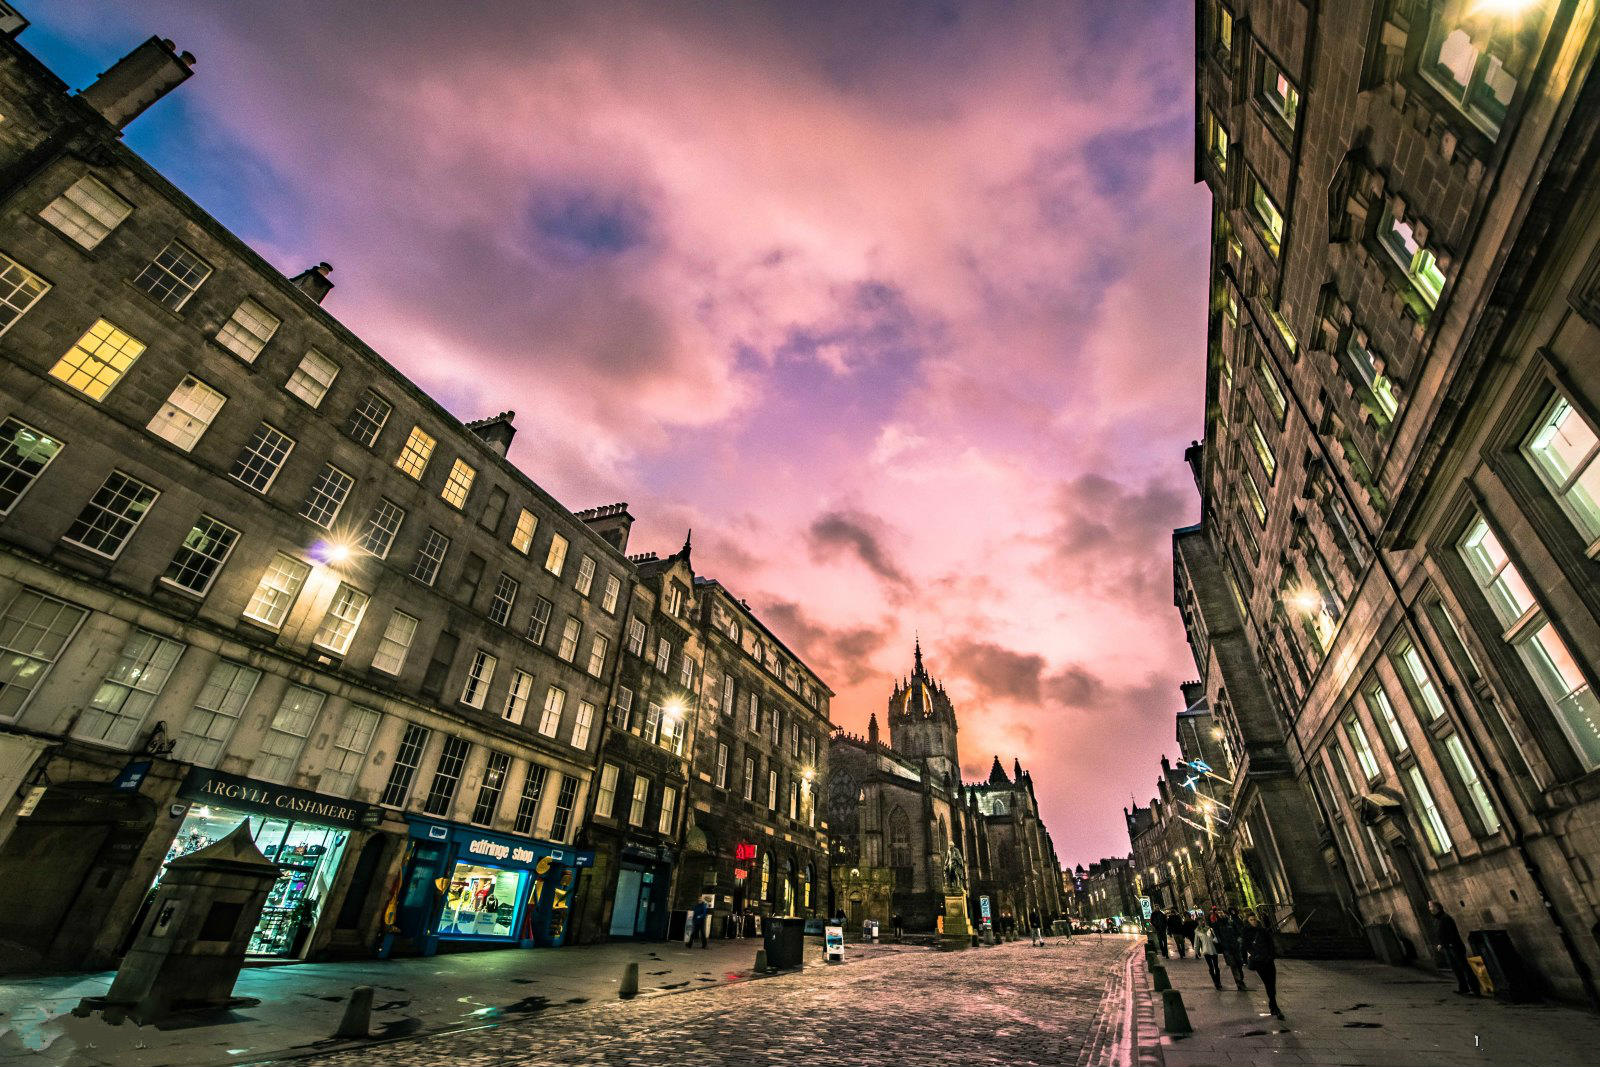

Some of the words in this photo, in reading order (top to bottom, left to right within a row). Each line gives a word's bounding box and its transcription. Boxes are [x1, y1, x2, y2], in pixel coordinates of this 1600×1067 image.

[200, 779, 270, 804] ARGYLL
[275, 795, 358, 821] CASHMERE
[512, 847, 534, 864] shop
